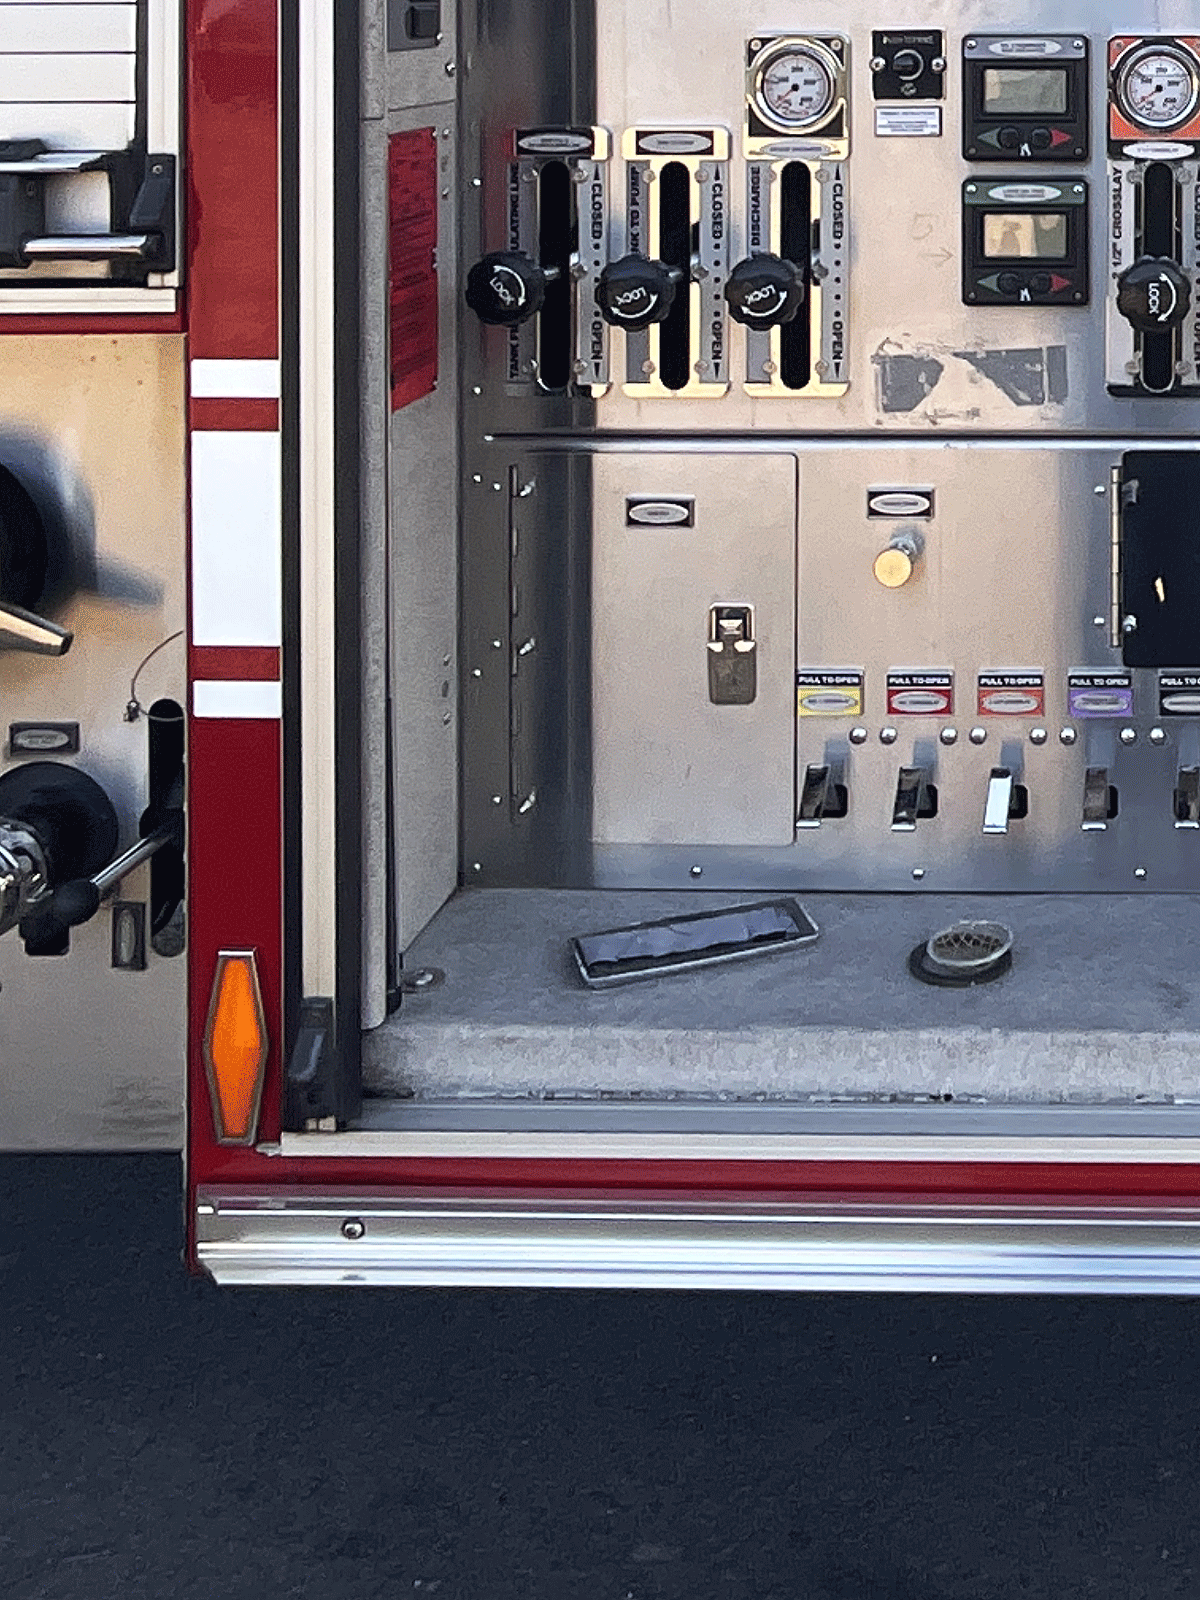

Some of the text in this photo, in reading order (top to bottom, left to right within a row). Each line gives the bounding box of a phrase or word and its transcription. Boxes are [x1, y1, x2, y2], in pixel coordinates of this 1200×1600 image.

[630, 166, 640, 207] PUMP
[1112, 168, 1123, 240] CROSSLAY
[591, 183, 602, 240] CLOSED
[712, 183, 723, 240] CLOSED
[751, 166, 760, 247] DISCHARGE
[832, 183, 843, 240] CLOSED
[490, 276, 515, 306] LOCK
[615, 286, 646, 305] LOCK
[745, 284, 776, 305] LOCK
[1149, 283, 1159, 314] LOCK
[592, 321, 603, 360] OPEN
[712, 321, 723, 360] OPEN
[832, 321, 843, 360] OPEN
[889, 677, 949, 685] PULL TO OPEN
[1070, 678, 1129, 686] PULL TO OPEN
[1161, 678, 1183, 686] PULL
[1185, 678, 1197, 686] TO
